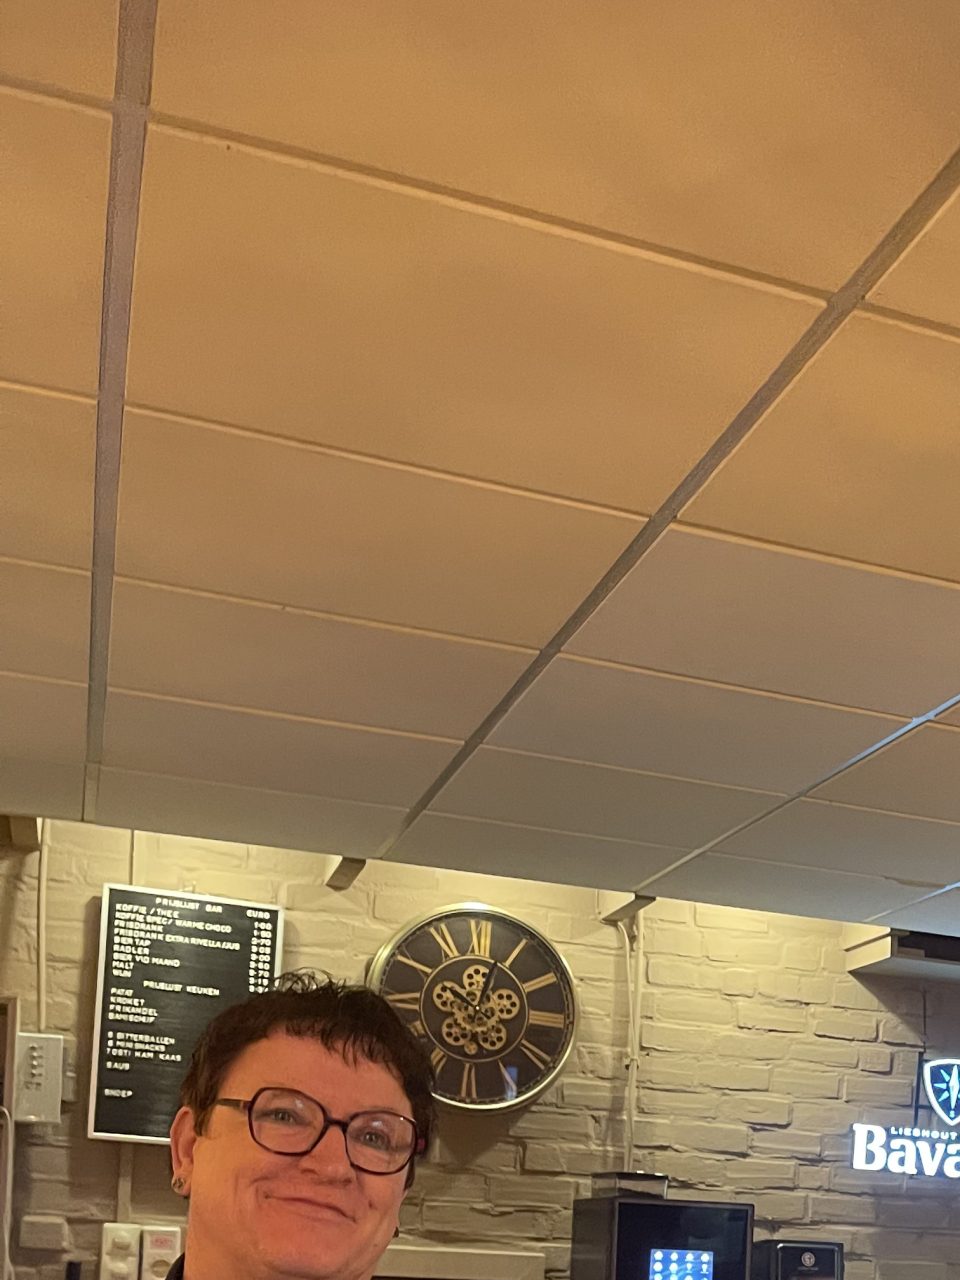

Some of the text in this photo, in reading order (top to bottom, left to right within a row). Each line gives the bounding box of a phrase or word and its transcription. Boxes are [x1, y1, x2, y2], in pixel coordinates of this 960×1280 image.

[115, 903, 147, 914] KOFFIE
[246, 909, 271, 920] EURO
[135, 938, 151, 947] TAP
[113, 944, 150, 955] RADLER
[890, 1125, 958, 1141] LIESHOUT
